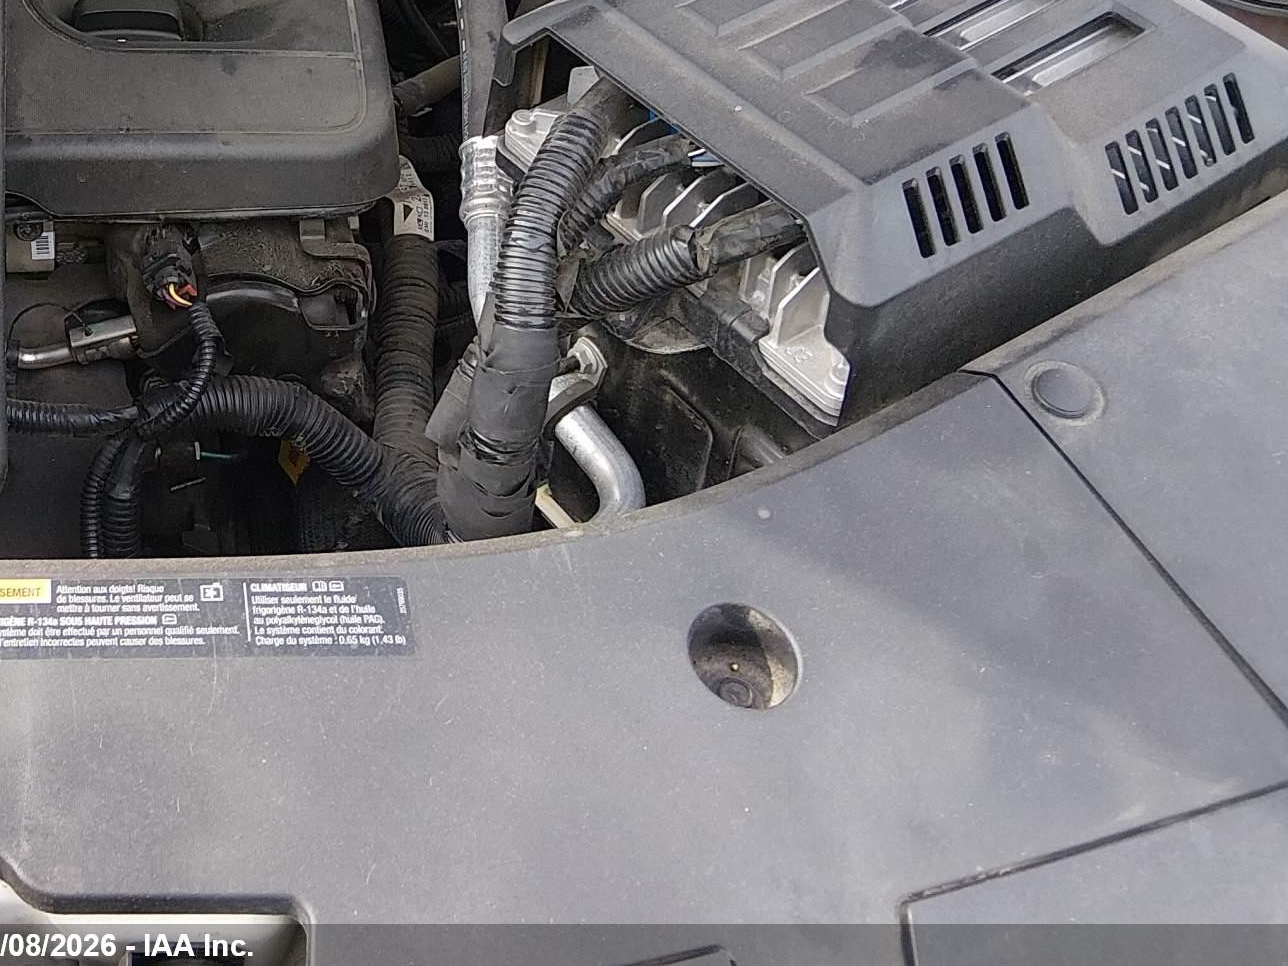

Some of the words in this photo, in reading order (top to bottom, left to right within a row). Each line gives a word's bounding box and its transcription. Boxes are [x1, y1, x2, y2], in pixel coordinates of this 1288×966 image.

[56, 585, 92, 594] Attention
[94, 586, 108, 594] aux
[138, 584, 164, 594] Risque
[57, 594, 67, 603] de
[69, 594, 108, 603] blessures.
[110, 594, 120, 603] Le
[121, 594, 163, 603] ventilateur
[184, 594, 194, 602] se
[252, 596, 278, 605] Utiliser
[281, 595, 322, 604] seulement
[324, 595, 331, 604] le
[57, 604, 83, 613] mettre
[92, 604, 120, 612] tourner
[143, 603, 200, 612] avertissement.
[252, 606, 296, 615] frigorigène
[297, 605, 327, 614] R-134a
[339, 605, 349, 613] de
[28, 618, 58, 626] R-134a
[60, 617, 83, 626] SOUS
[85, 616, 113, 626] HAUTE
[115, 616, 157, 625] PRESSION
[254, 617, 264, 625] au
[340, 615, 362, 625] (huile
[364, 615, 385, 624] PAG).
[28, 627, 44, 636] doit
[63, 626, 95, 635] effectué
[97, 628, 110, 637] par
[124, 627, 163, 636] personnel
[165, 626, 194, 637] qualifié
[196, 626, 240, 635] seulement.
[254, 625, 265, 635] Le
[267, 626, 300, 636] système
[302, 625, 335, 635] contient
[337, 626, 347, 634] du
[350, 625, 384, 634] colorant.
[41, 637, 84, 646] incorrectes
[86, 637, 118, 647] peuvent
[120, 638, 148, 646] causer
[149, 637, 164, 646] des
[165, 636, 205, 645] blessures.
[256, 636, 285, 646] Charge
[286, 636, 298, 645] du
[299, 636, 333, 646] système
[339, 636, 357, 644] 0.65
[360, 636, 370, 646] kg
[372, 635, 394, 646] (1.43
[395, 635, 406, 644] lb)
